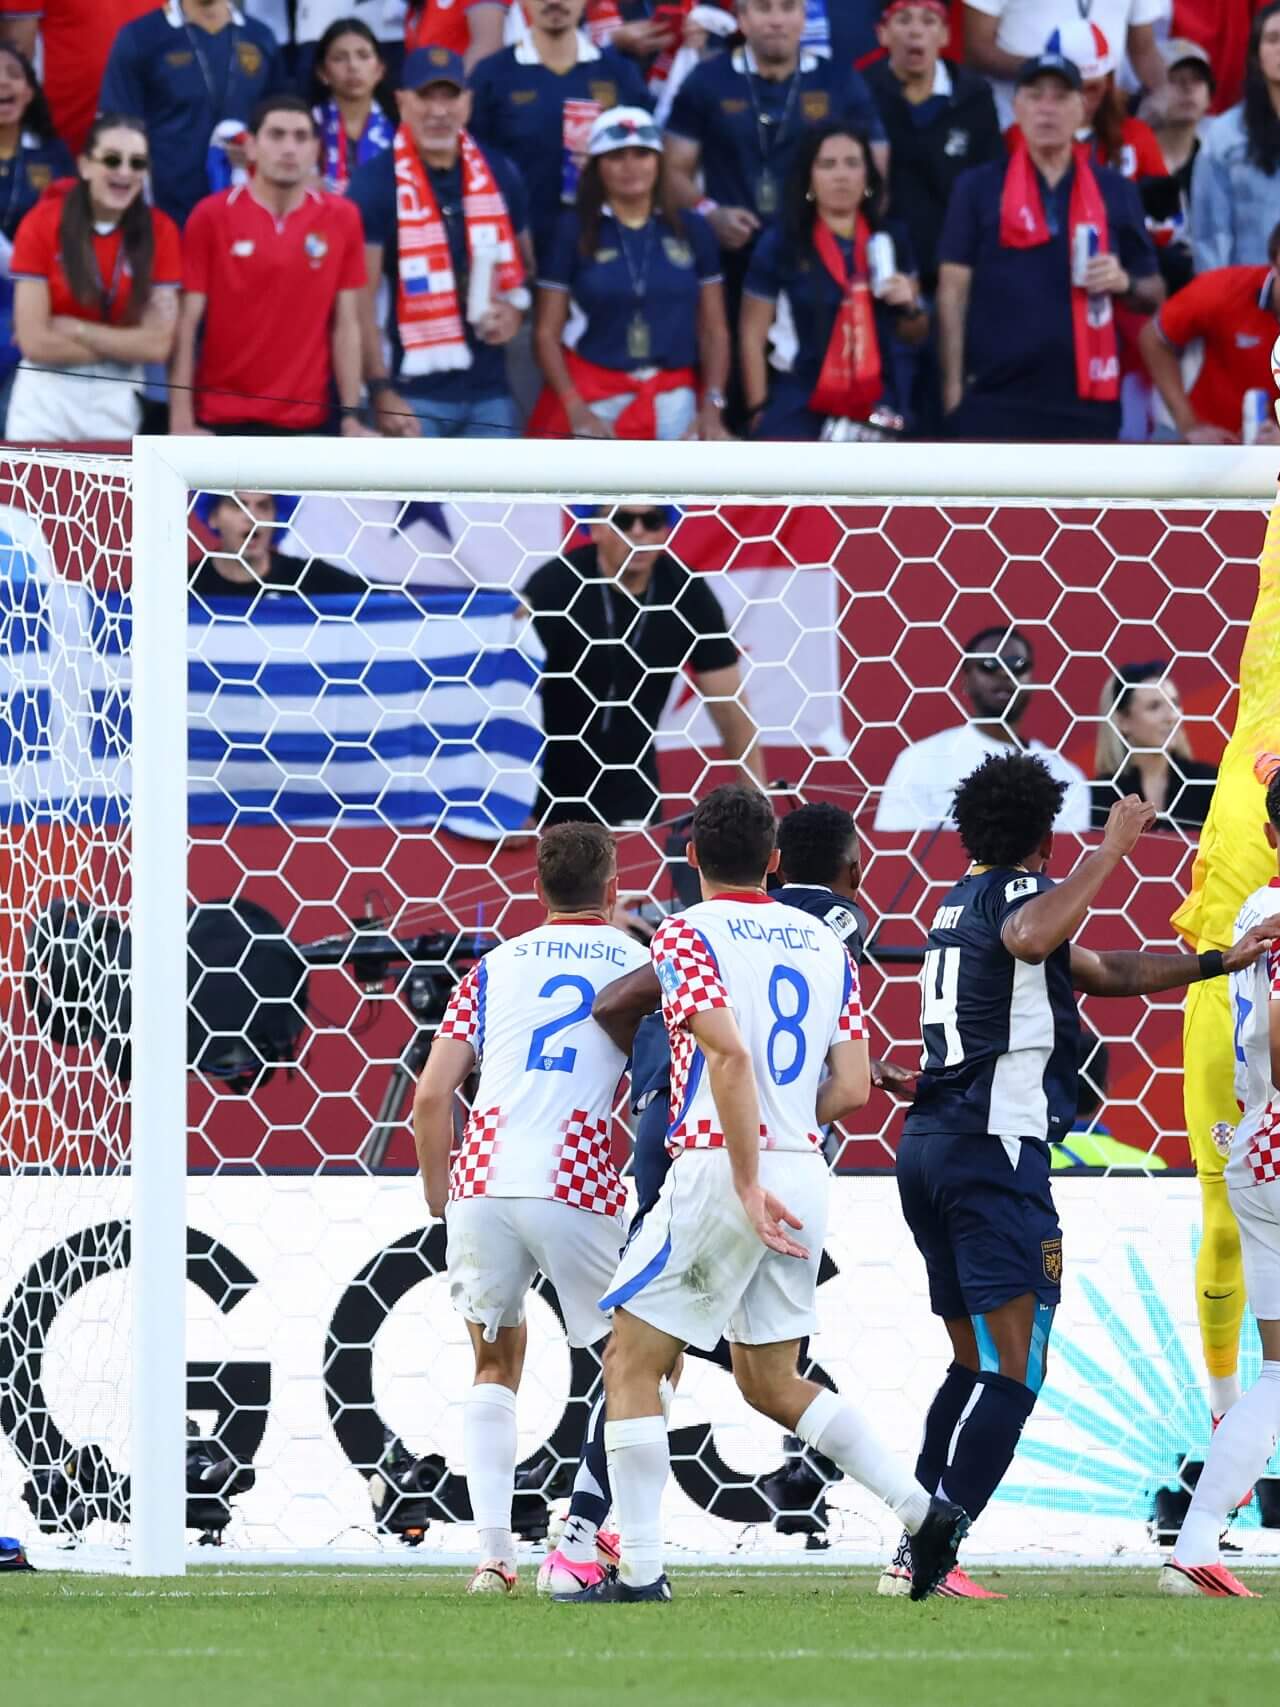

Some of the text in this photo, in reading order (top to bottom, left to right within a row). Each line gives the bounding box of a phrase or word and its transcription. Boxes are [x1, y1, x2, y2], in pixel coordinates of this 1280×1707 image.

[513, 940, 627, 967] STANIŠIĆ
[727, 917, 820, 952] KOVAČIĆ
[525, 974, 596, 1073] 2
[767, 964, 810, 1086] 8
